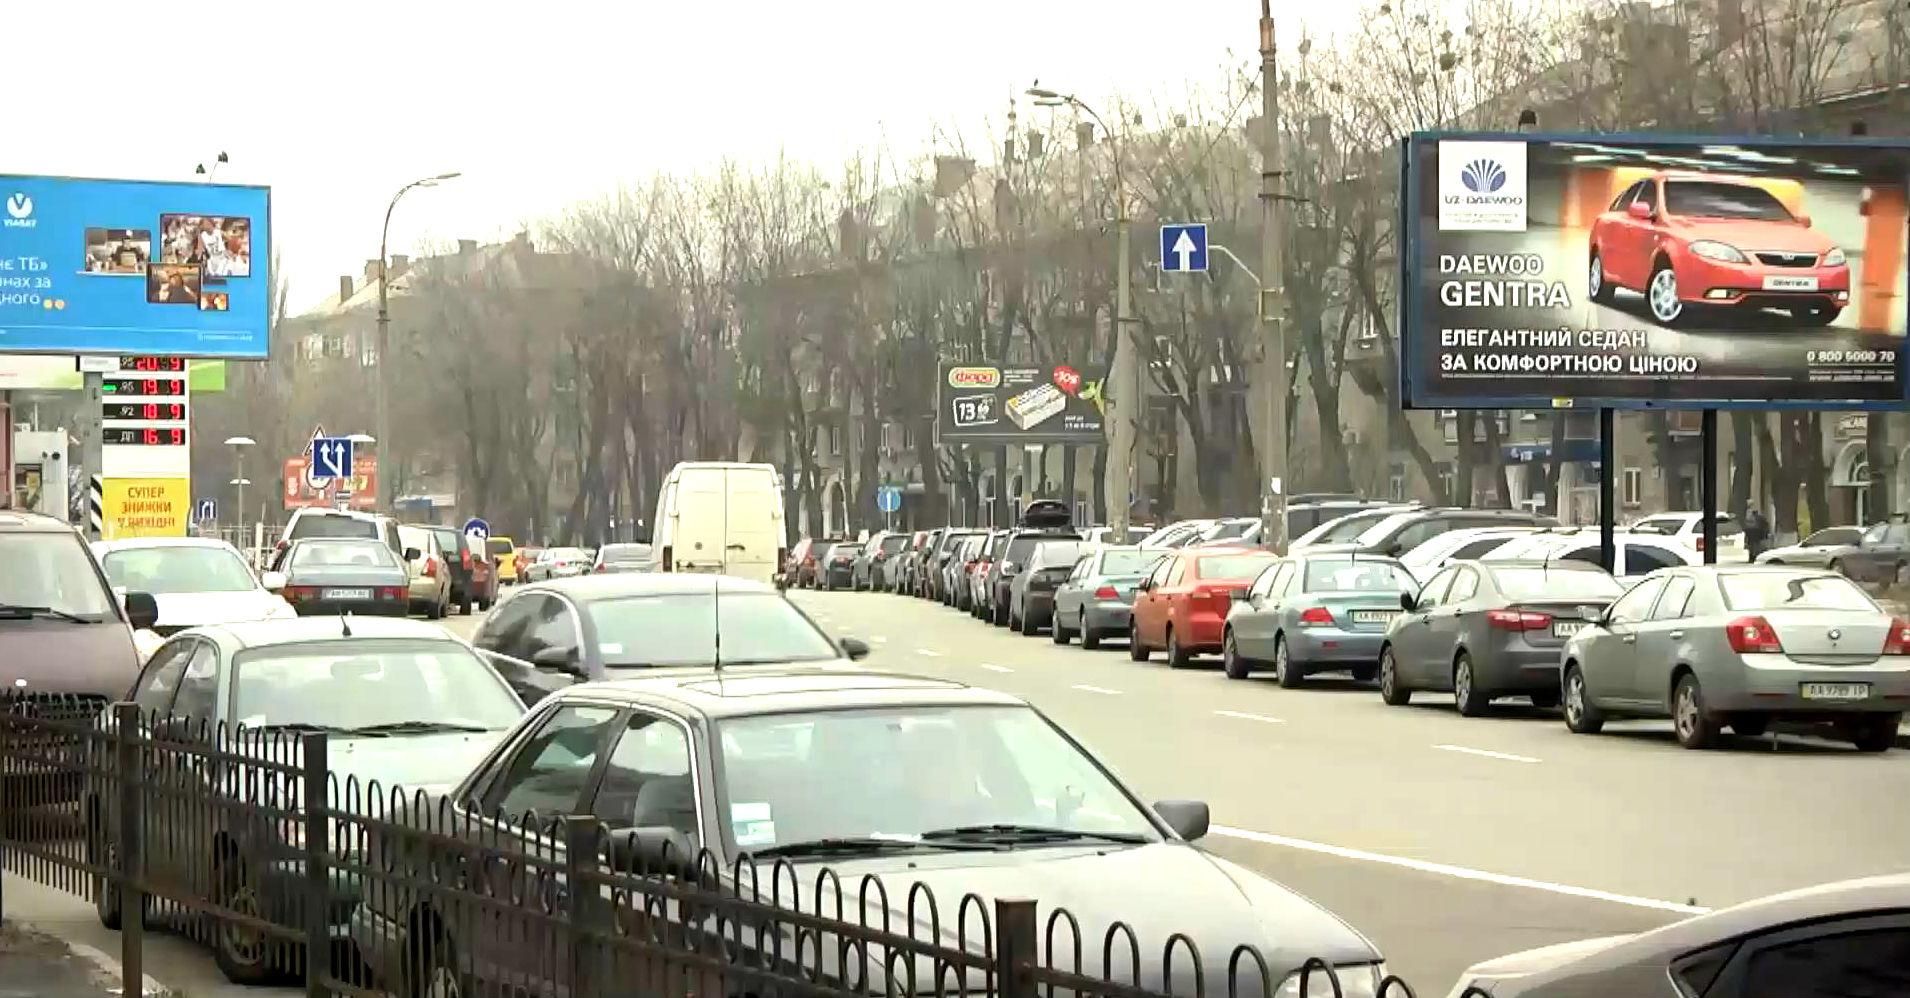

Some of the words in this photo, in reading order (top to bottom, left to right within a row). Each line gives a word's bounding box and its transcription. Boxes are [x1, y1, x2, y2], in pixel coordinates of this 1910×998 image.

[1440, 255, 1544, 274] DAEWOO
[34, 277, 51, 288] за
[1440, 281, 1571, 307] GENTRA
[1441, 327, 1572, 347] ЕЛЕГАНТНИЙ
[1578, 329, 1646, 350] СЕДАН
[1441, 354, 1467, 371] ЗА
[1474, 354, 1622, 372] КОМФОРТНОЮ
[1629, 355, 1698, 375] ЦІНОЮ
[1807, 350, 1815, 362] 0
[1879, 350, 1895, 362] 70
[959, 402, 975, 421] 13
[128, 487, 165, 498] СУПЕР
[121, 501, 171, 514] ЗНИЖКИ
